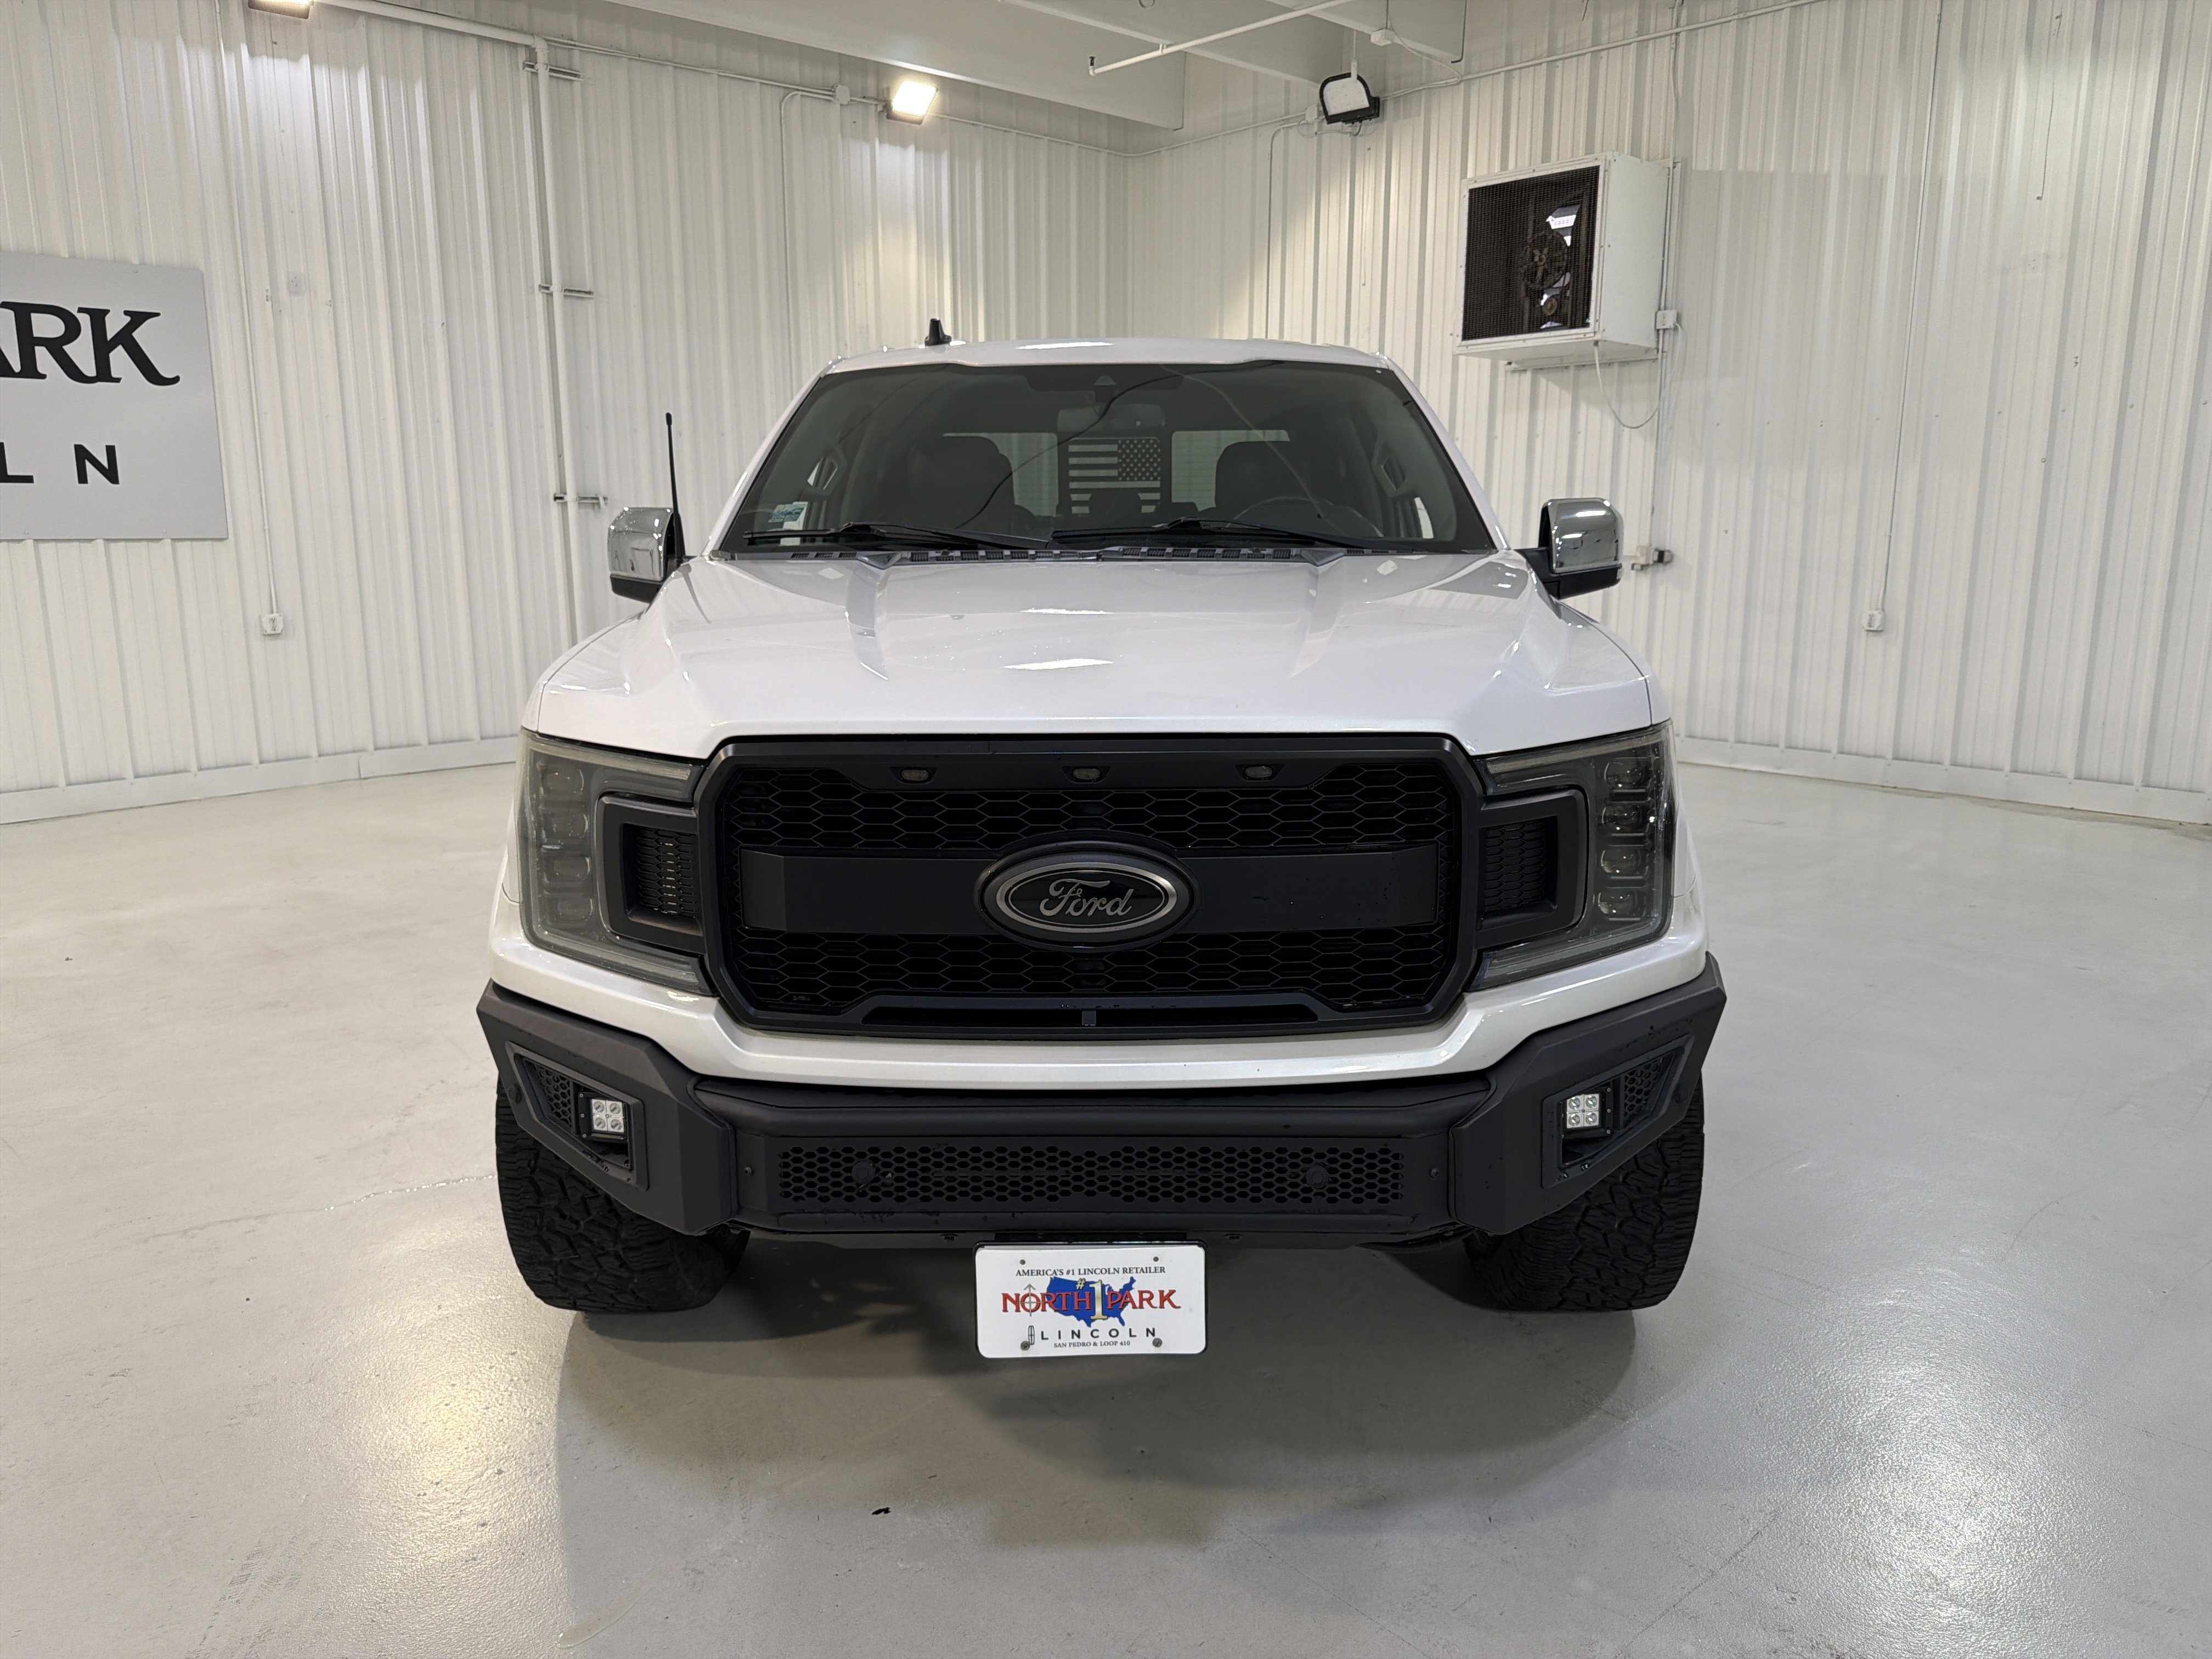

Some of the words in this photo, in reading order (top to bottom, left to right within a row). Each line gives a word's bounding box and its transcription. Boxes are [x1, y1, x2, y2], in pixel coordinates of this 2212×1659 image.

[1040, 878, 1134, 916] Ford
[1015, 1268, 1064, 1277] AMERICA'S
[1078, 1267, 1120, 1276] LINCOLN
[1122, 1266, 1166, 1274] RETAILER
[1001, 1291, 1091, 1313] NORTH
[1107, 1289, 1181, 1310] PARK
[1041, 1328, 1155, 1340] LINCOLN
